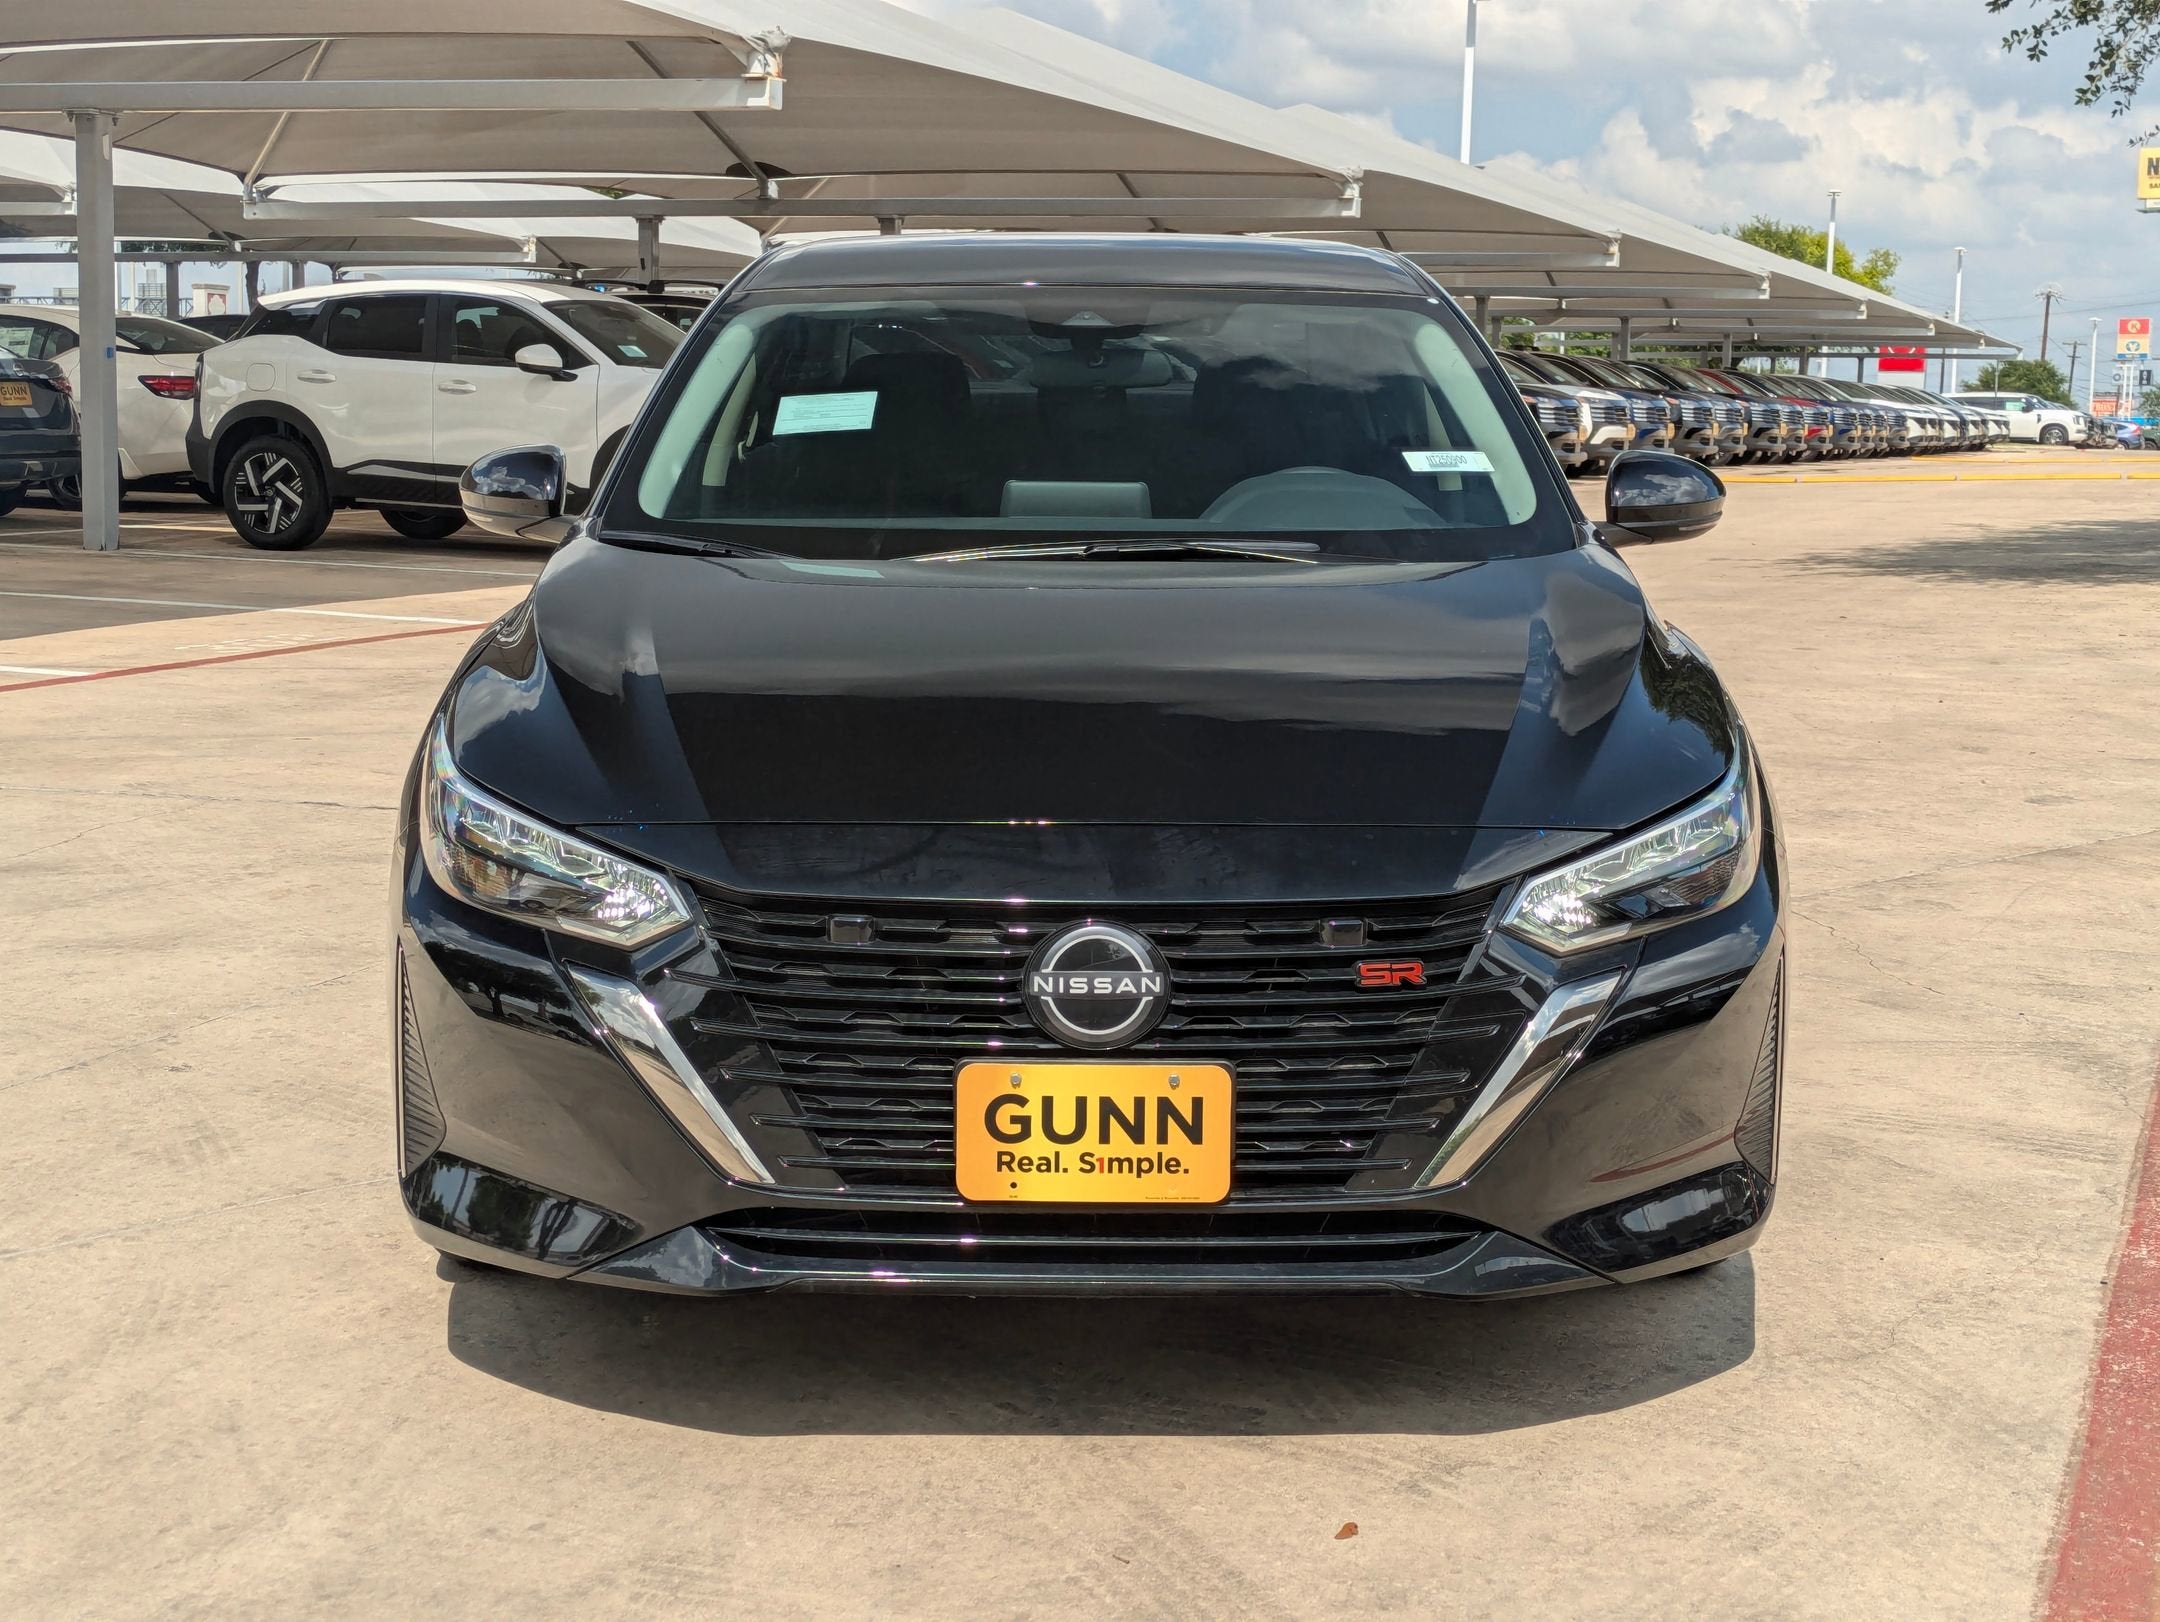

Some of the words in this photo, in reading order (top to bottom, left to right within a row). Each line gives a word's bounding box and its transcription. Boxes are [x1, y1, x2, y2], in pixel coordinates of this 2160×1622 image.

[0, 385, 28, 396] GUNN
[1033, 975, 1160, 994] NISSAN
[1359, 961, 1425, 986] SR
[984, 1093, 1204, 1145] GUNN
[996, 1151, 1069, 1174] Real.
